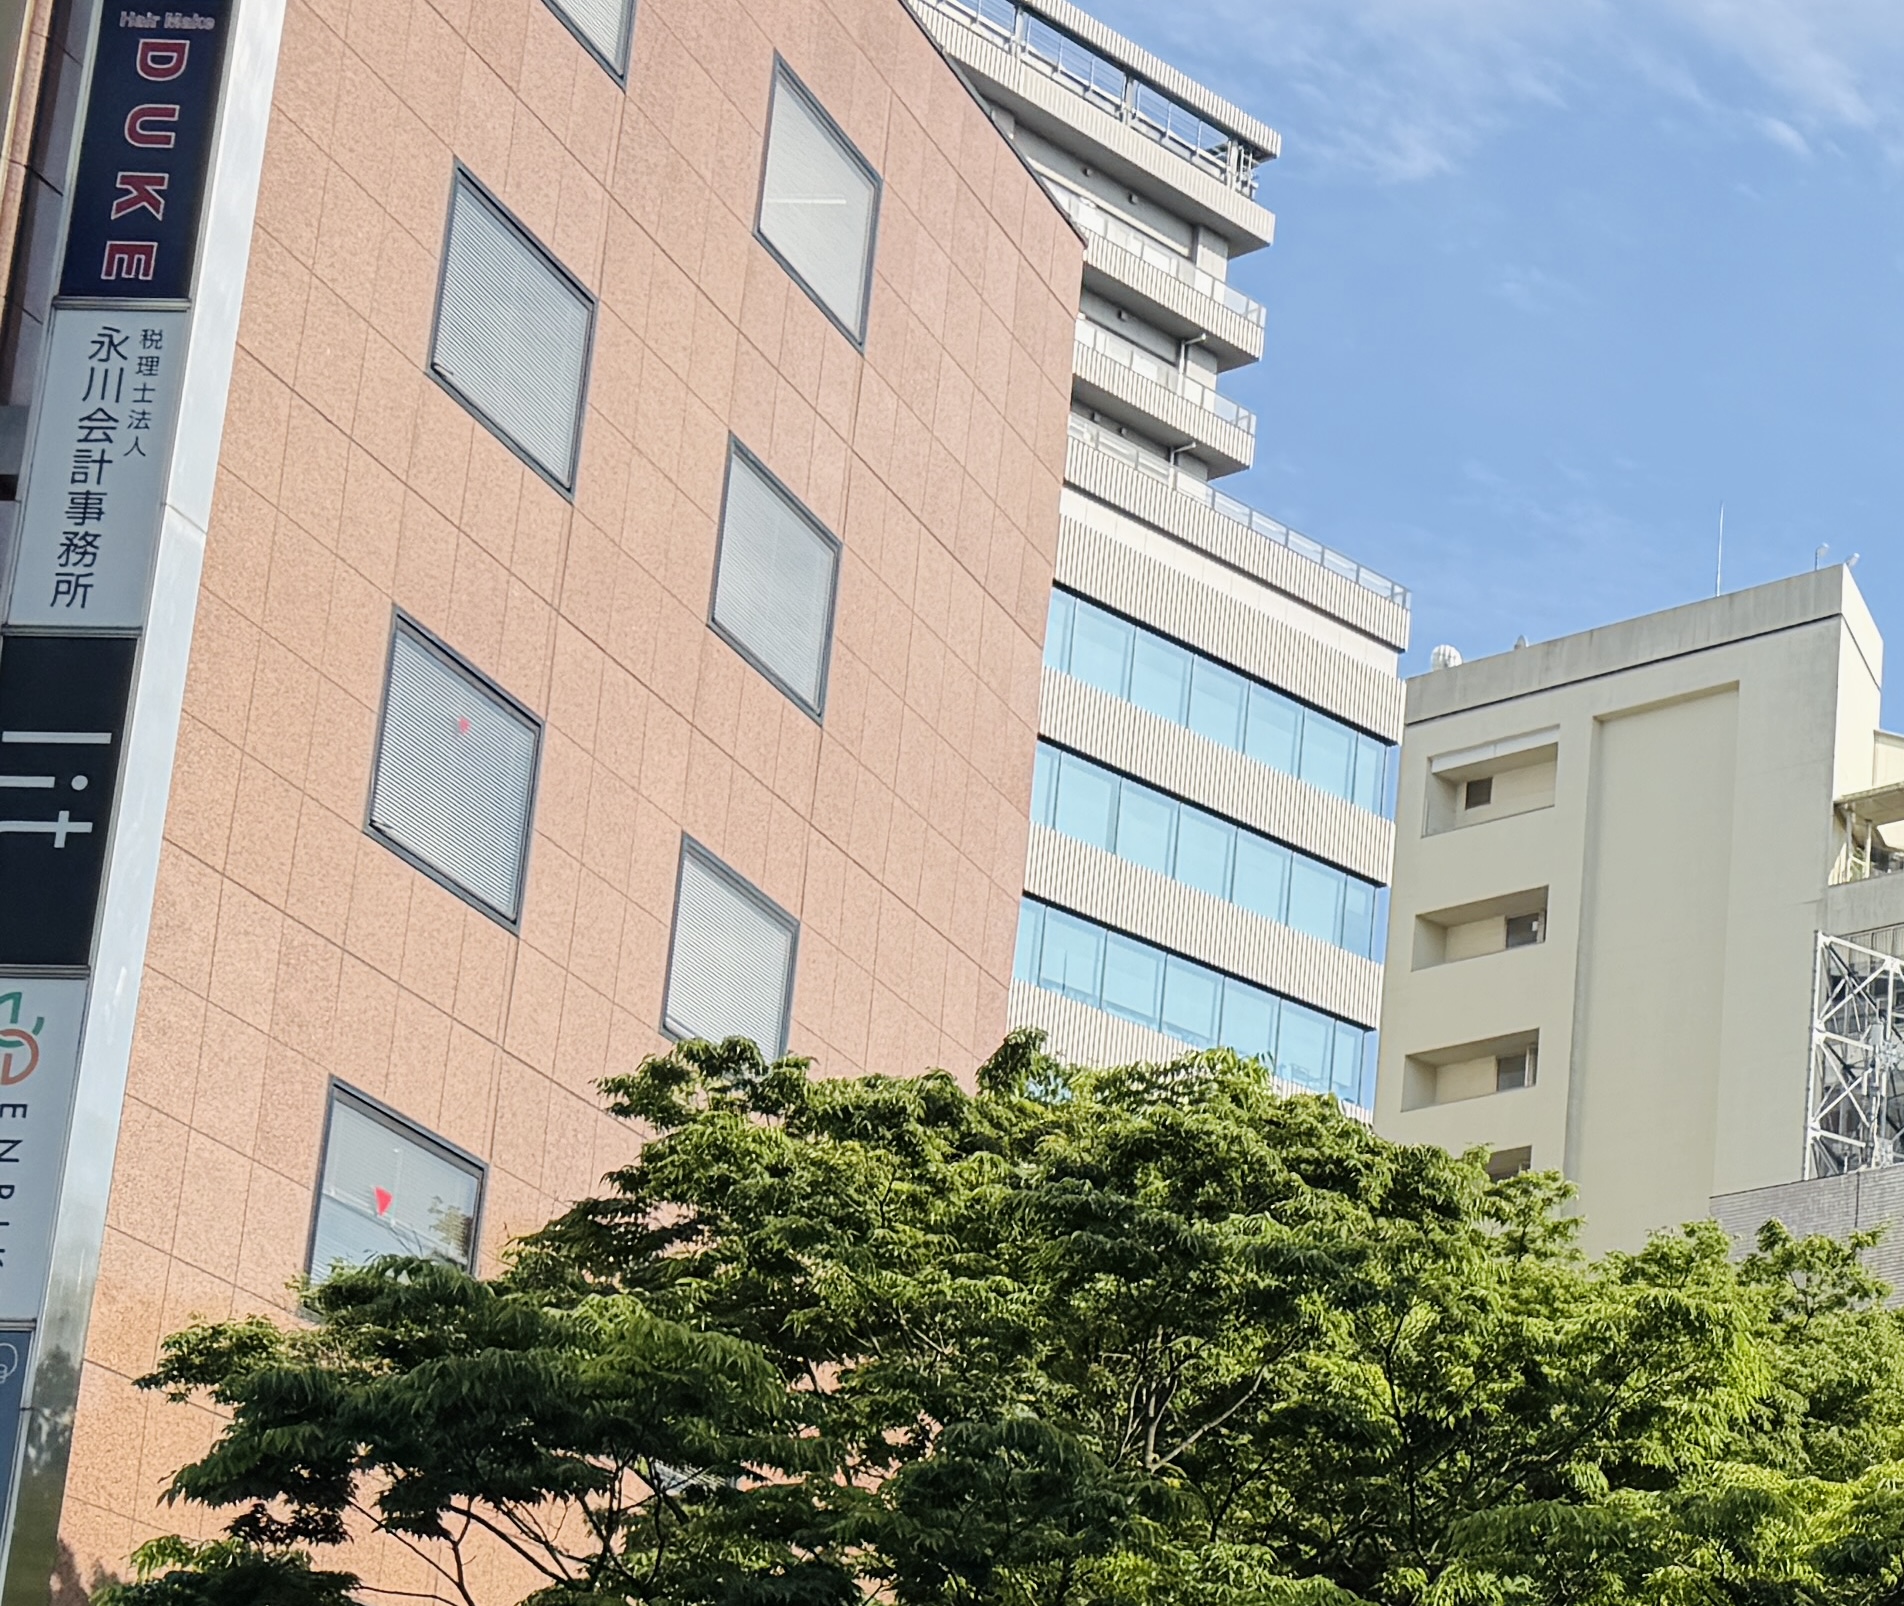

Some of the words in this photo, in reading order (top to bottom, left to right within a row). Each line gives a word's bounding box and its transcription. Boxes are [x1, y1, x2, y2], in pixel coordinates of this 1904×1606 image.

[119, 11, 160, 29] Hair
[163, 12, 216, 31] Make
[100, 38, 190, 281] DUKE
[50, 326, 130, 609] 永川会計事務所
[123, 328, 163, 458] 税理士法人
